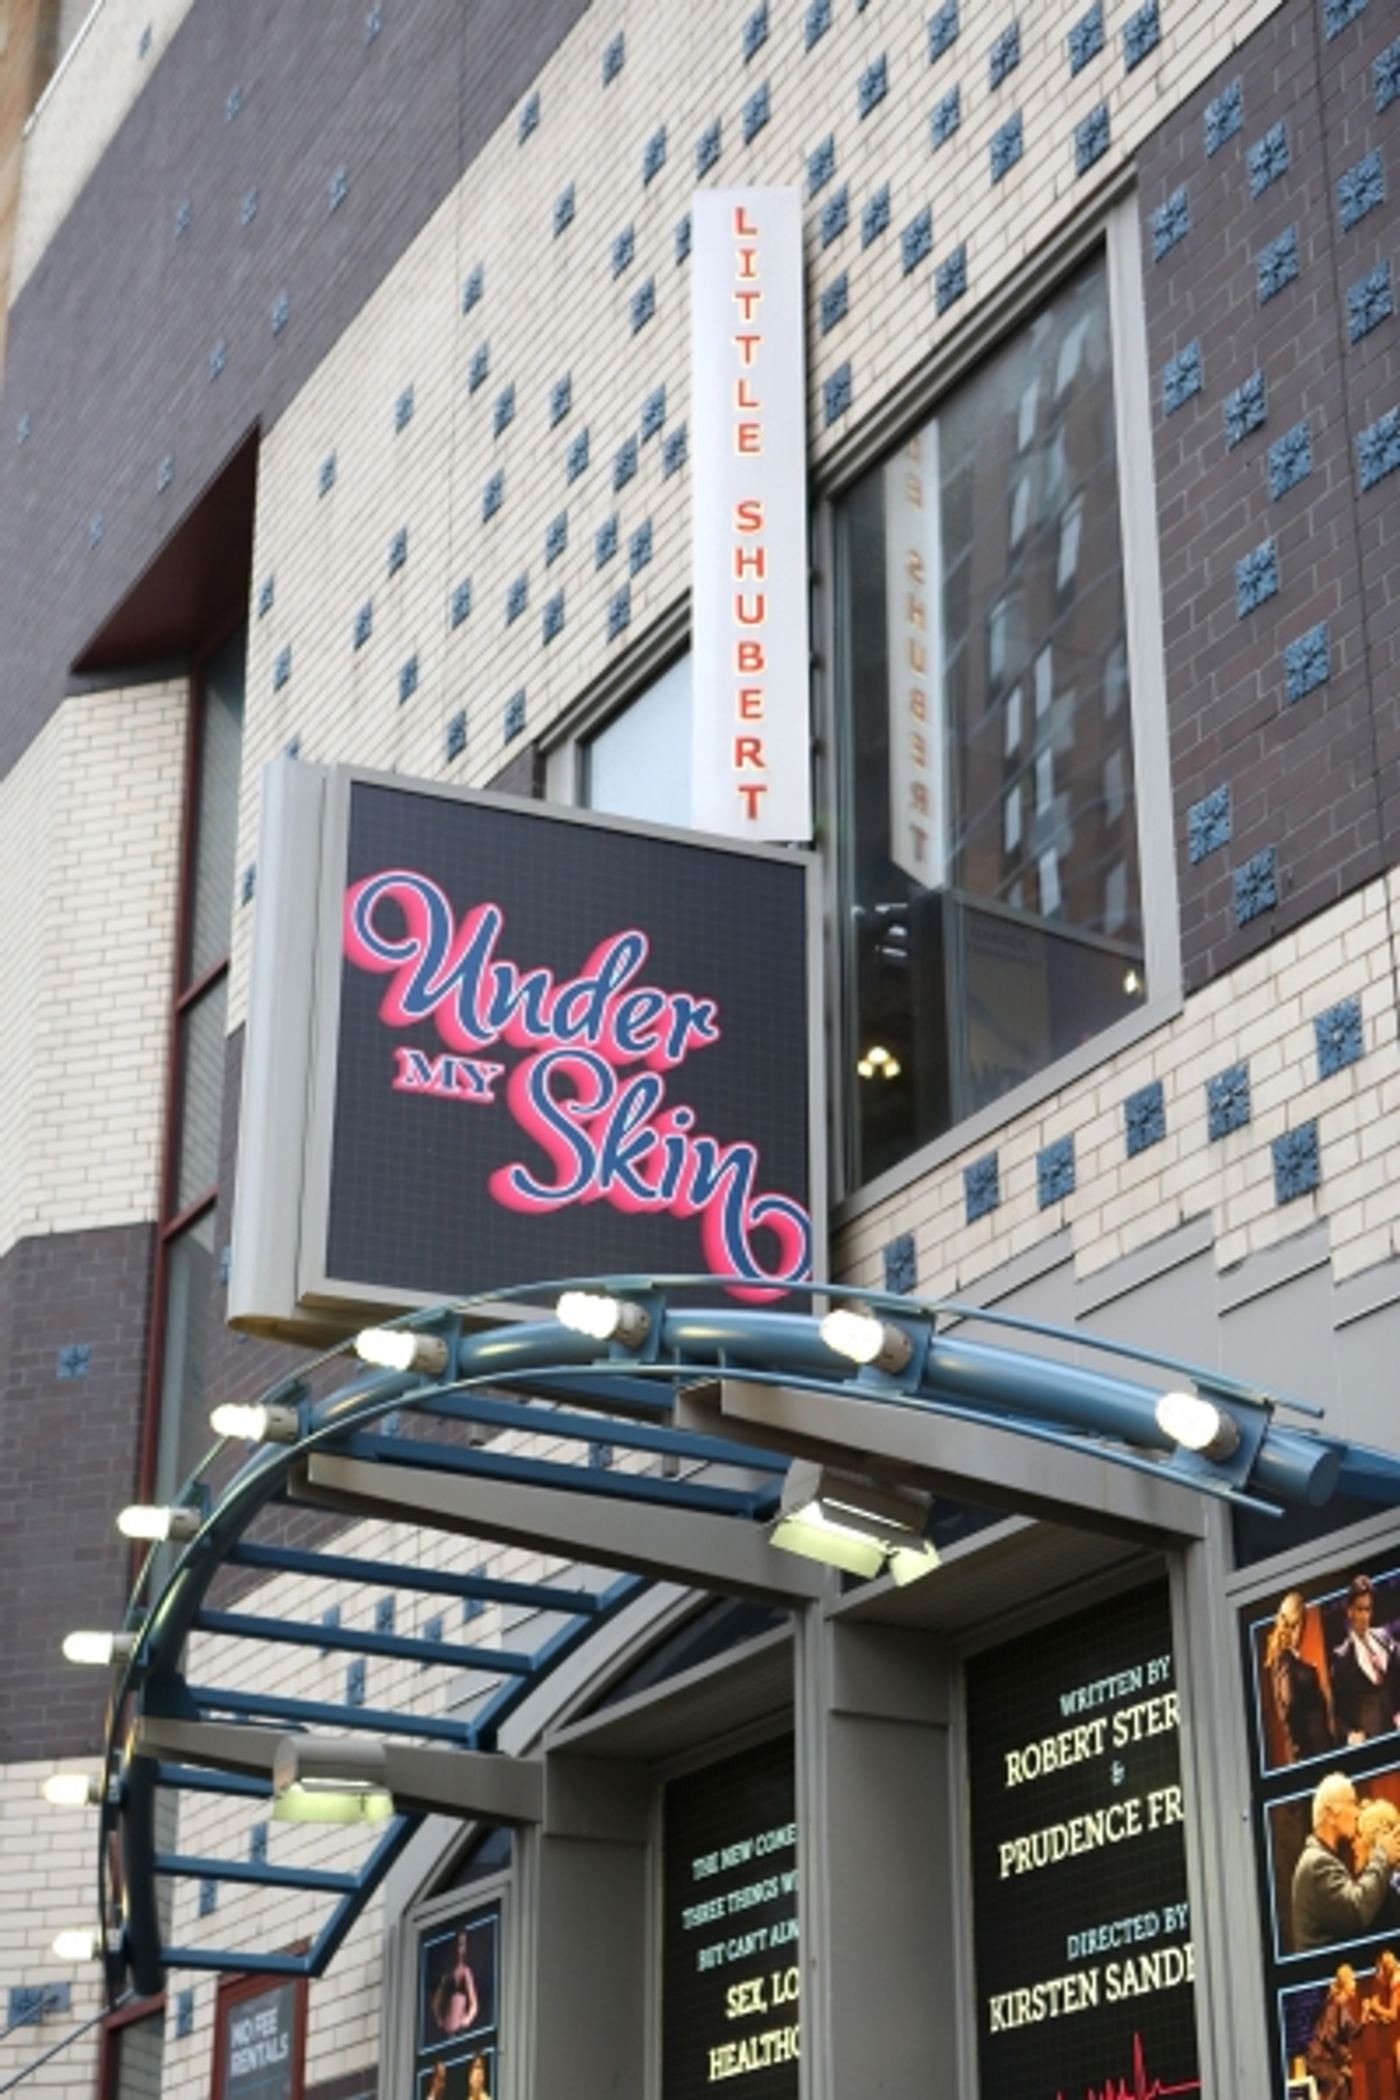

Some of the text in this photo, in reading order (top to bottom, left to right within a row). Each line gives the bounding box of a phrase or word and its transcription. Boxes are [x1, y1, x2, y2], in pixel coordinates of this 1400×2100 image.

[734, 205, 767, 822] LITTLE SHUBERT
[343, 869, 721, 1073] Under
[393, 1046, 504, 1104] MY
[489, 1046, 812, 1302] Skin
[1059, 1654, 1171, 1717] WRITTEN BY
[1004, 1691, 1181, 1788] ROBERT STER
[1111, 1759, 1126, 1786] &
[720, 1838, 754, 1870] NEW
[998, 1785, 1185, 1880] PRUDENCE FR
[727, 1876, 779, 1914] THINGS
[1066, 1903, 1189, 1962] DIRECTED BY
[725, 1976, 768, 2021] SEX,
[989, 1966, 1100, 2034] KIRSTEN
[229, 2031, 289, 2078] RENTALS
